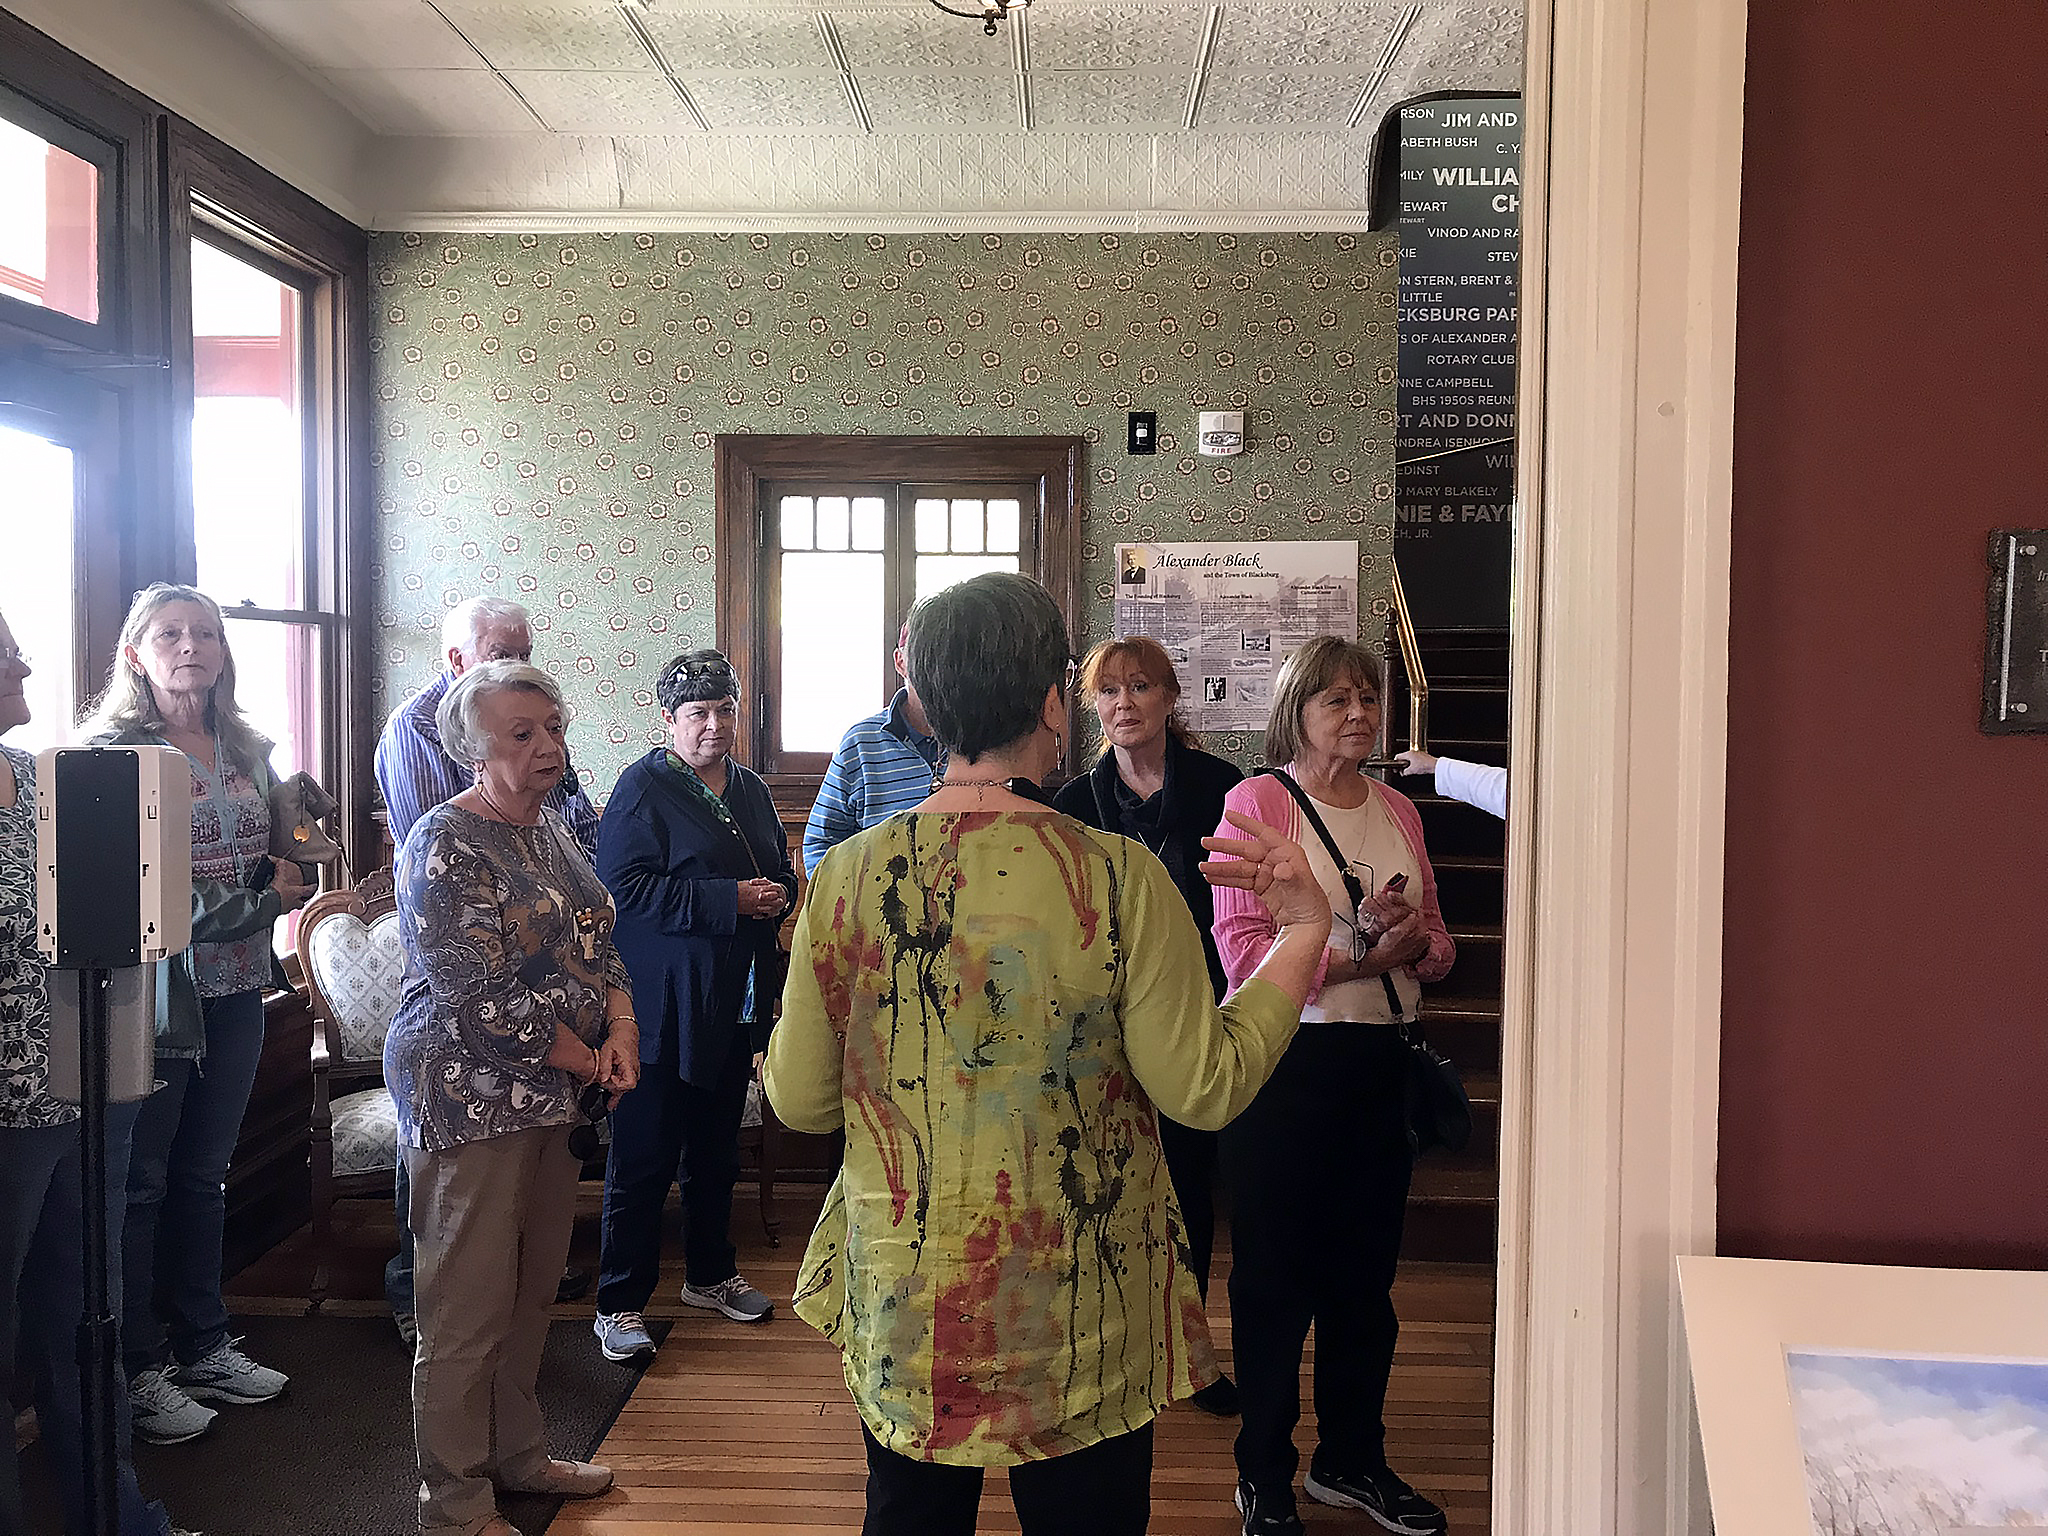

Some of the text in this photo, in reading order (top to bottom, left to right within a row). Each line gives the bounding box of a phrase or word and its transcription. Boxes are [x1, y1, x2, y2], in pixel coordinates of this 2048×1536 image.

[1400, 108, 1435, 119] RSON
[1441, 112, 1518, 128] JIM AND
[1400, 137, 1479, 148] ABETH BUSH
[1496, 144, 1520, 154] C. Y.
[1432, 167, 1520, 186] WILLIA
[1427, 228, 1469, 238] VINOD
[1471, 228, 1500, 238] AND
[1487, 252, 1518, 262] STEV
[1398, 276, 1411, 285] N
[1414, 275, 1458, 287] STERN,
[1460, 275, 1501, 285] BRENT
[1504, 275, 1513, 285] &
[1402, 292, 1443, 303] LITTLE
[1398, 307, 1481, 322] CKSBURG
[1411, 333, 1428, 343] OF
[1431, 333, 1507, 343] ALEXANDER
[1427, 354, 1515, 365] ROTARY CLUB
[1426, 377, 1494, 388] CAMPBELL
[1412, 396, 1437, 406] BHS
[1439, 396, 1475, 406] 1950S
[1418, 413, 1461, 428] AND
[1405, 486, 1442, 496] MARY
[1444, 486, 1499, 496] BLAKELY
[1438, 504, 1455, 523] &
[1414, 528, 1433, 539] JR.
[1152, 552, 1263, 570] Alexander Black
[1249, 571, 1280, 580] Blacksburg
